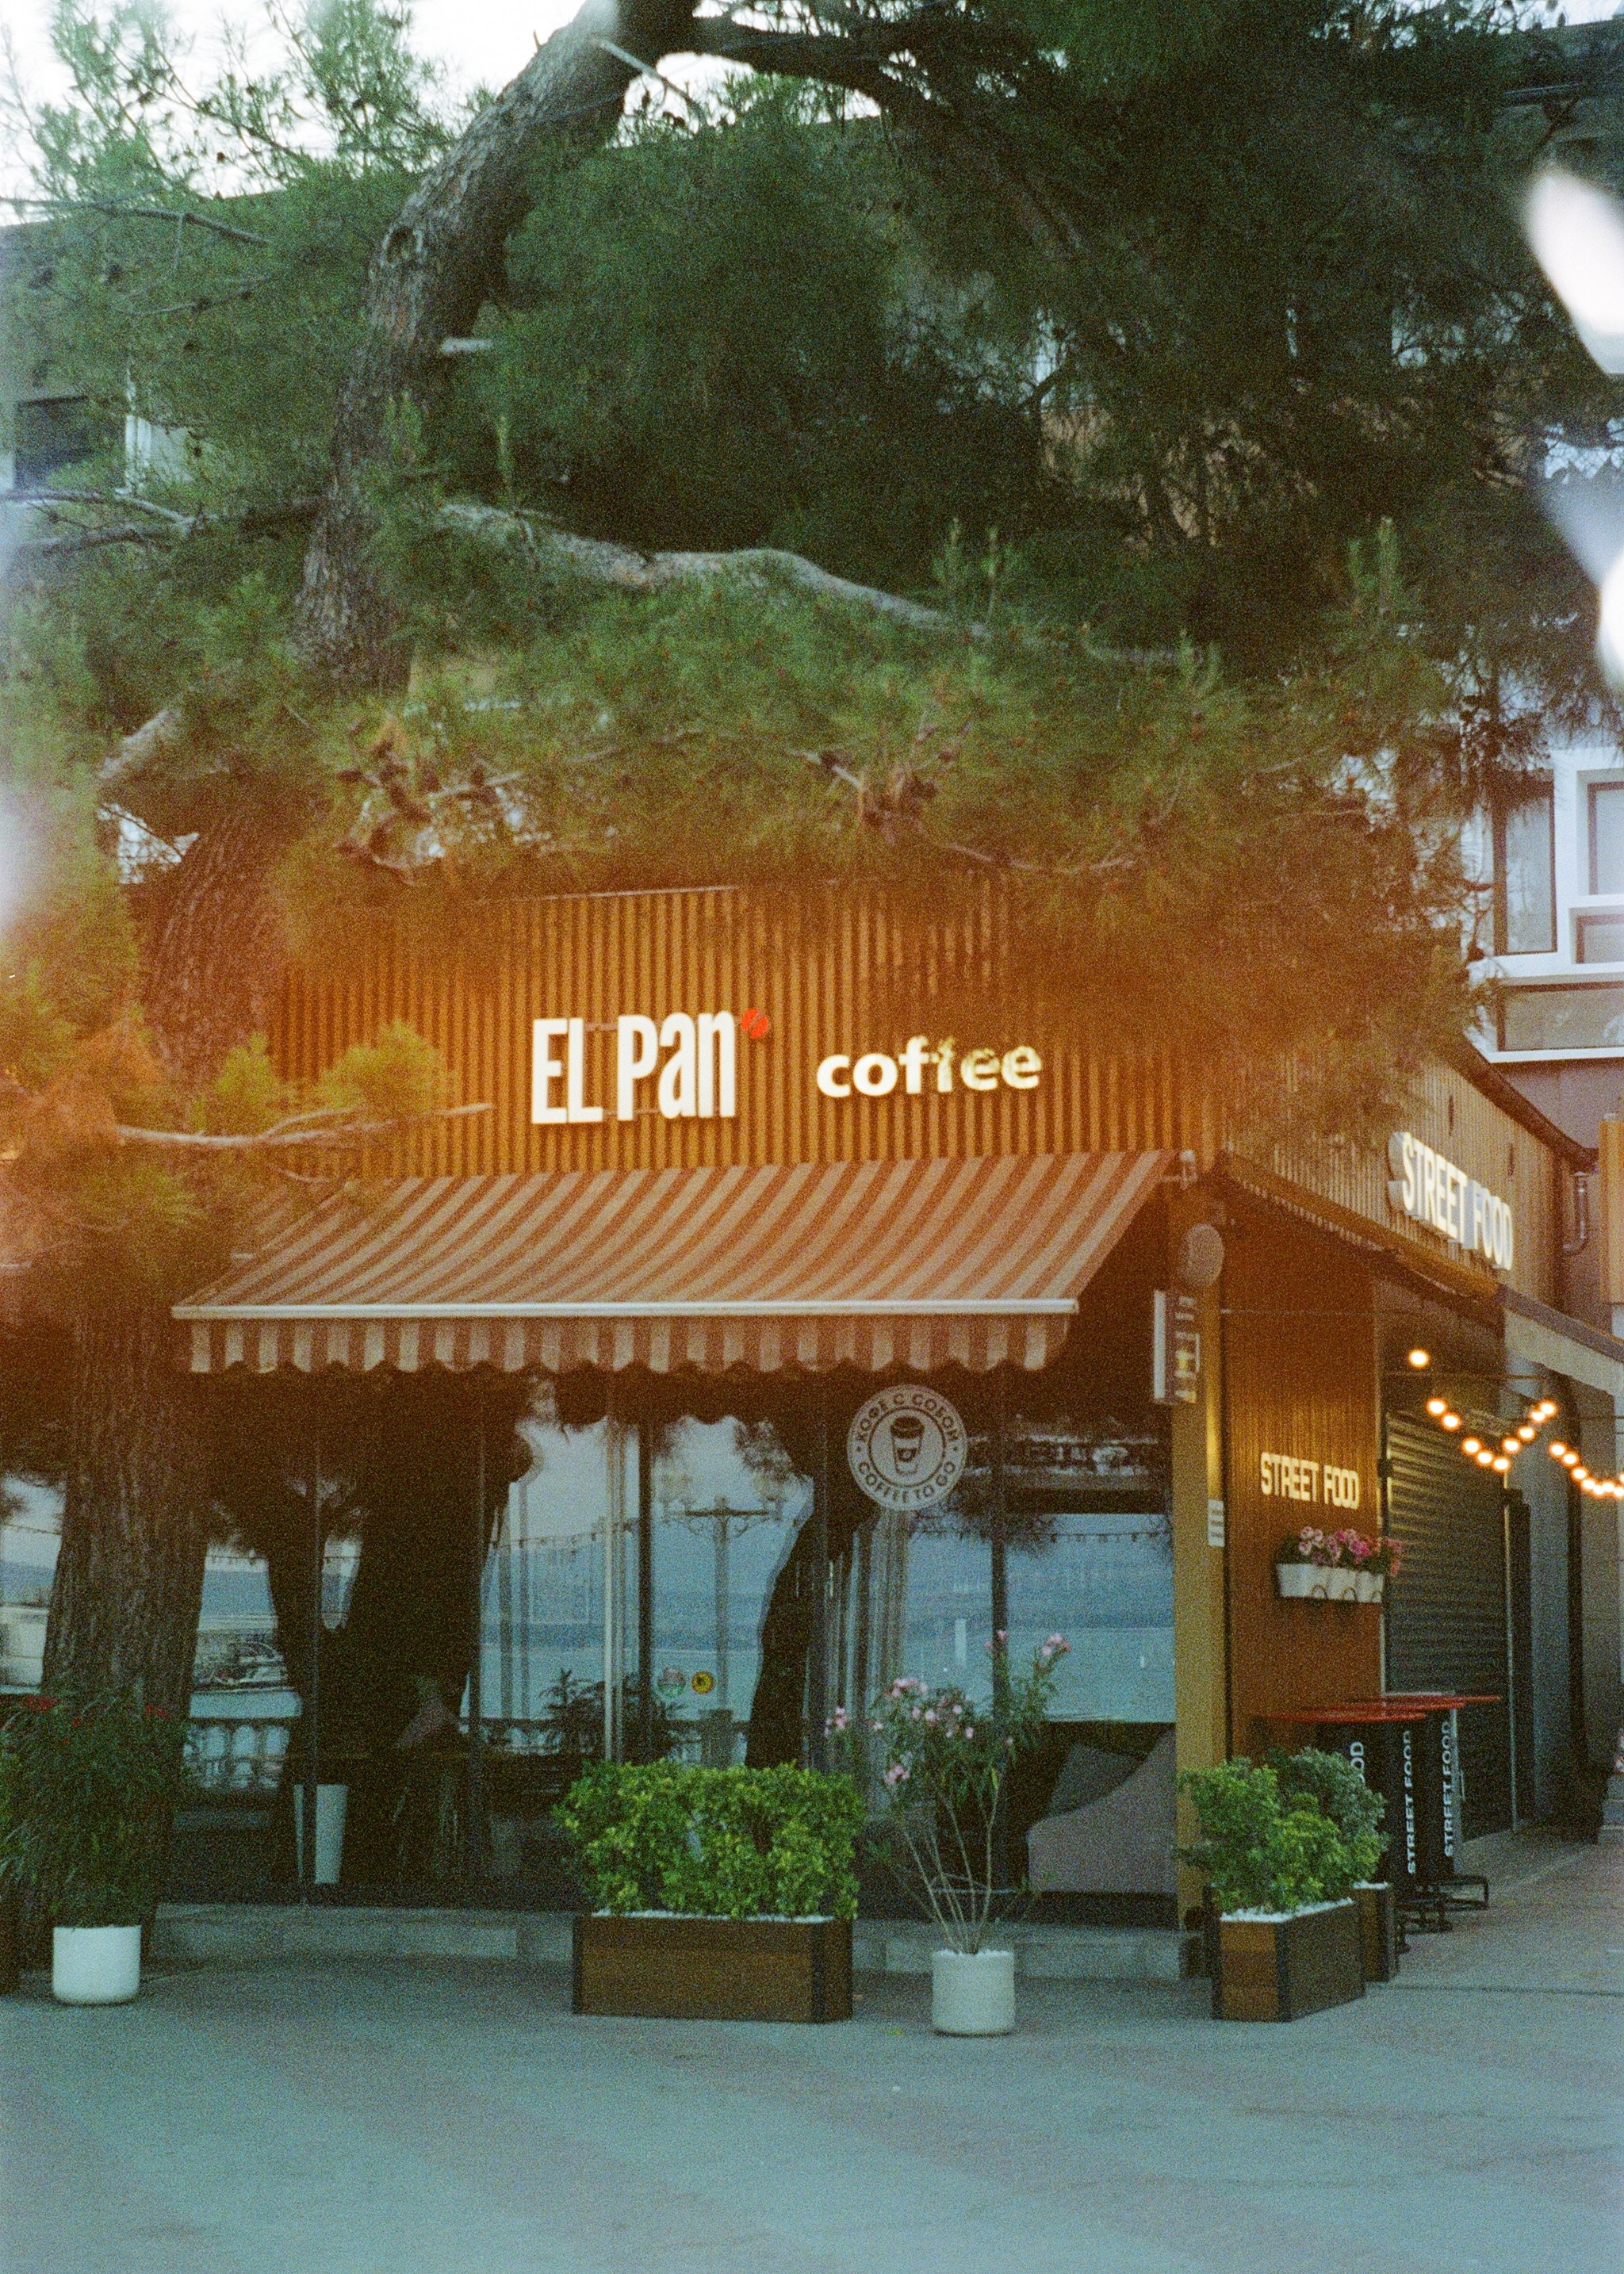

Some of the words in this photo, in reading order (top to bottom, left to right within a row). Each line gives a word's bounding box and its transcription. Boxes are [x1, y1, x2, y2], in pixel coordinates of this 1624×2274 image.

[531, 1016, 603, 1124] EL
[815, 1034, 1043, 1098] coffee
[1399, 1131, 1467, 1244] STREET
[1468, 1180, 1513, 1270] FOOD
[858, 1462, 908, 1503] COFFEE
[914, 1485, 934, 1499] TO
[1261, 1452, 1320, 1503] STREET
[1323, 1464, 1359, 1510] FOOD
[1403, 1730, 1413, 1788] FOOD
[1441, 1721, 1453, 1775] FOOD
[1404, 1794, 1416, 1874] STREET
[1442, 1781, 1454, 1857] STREET
